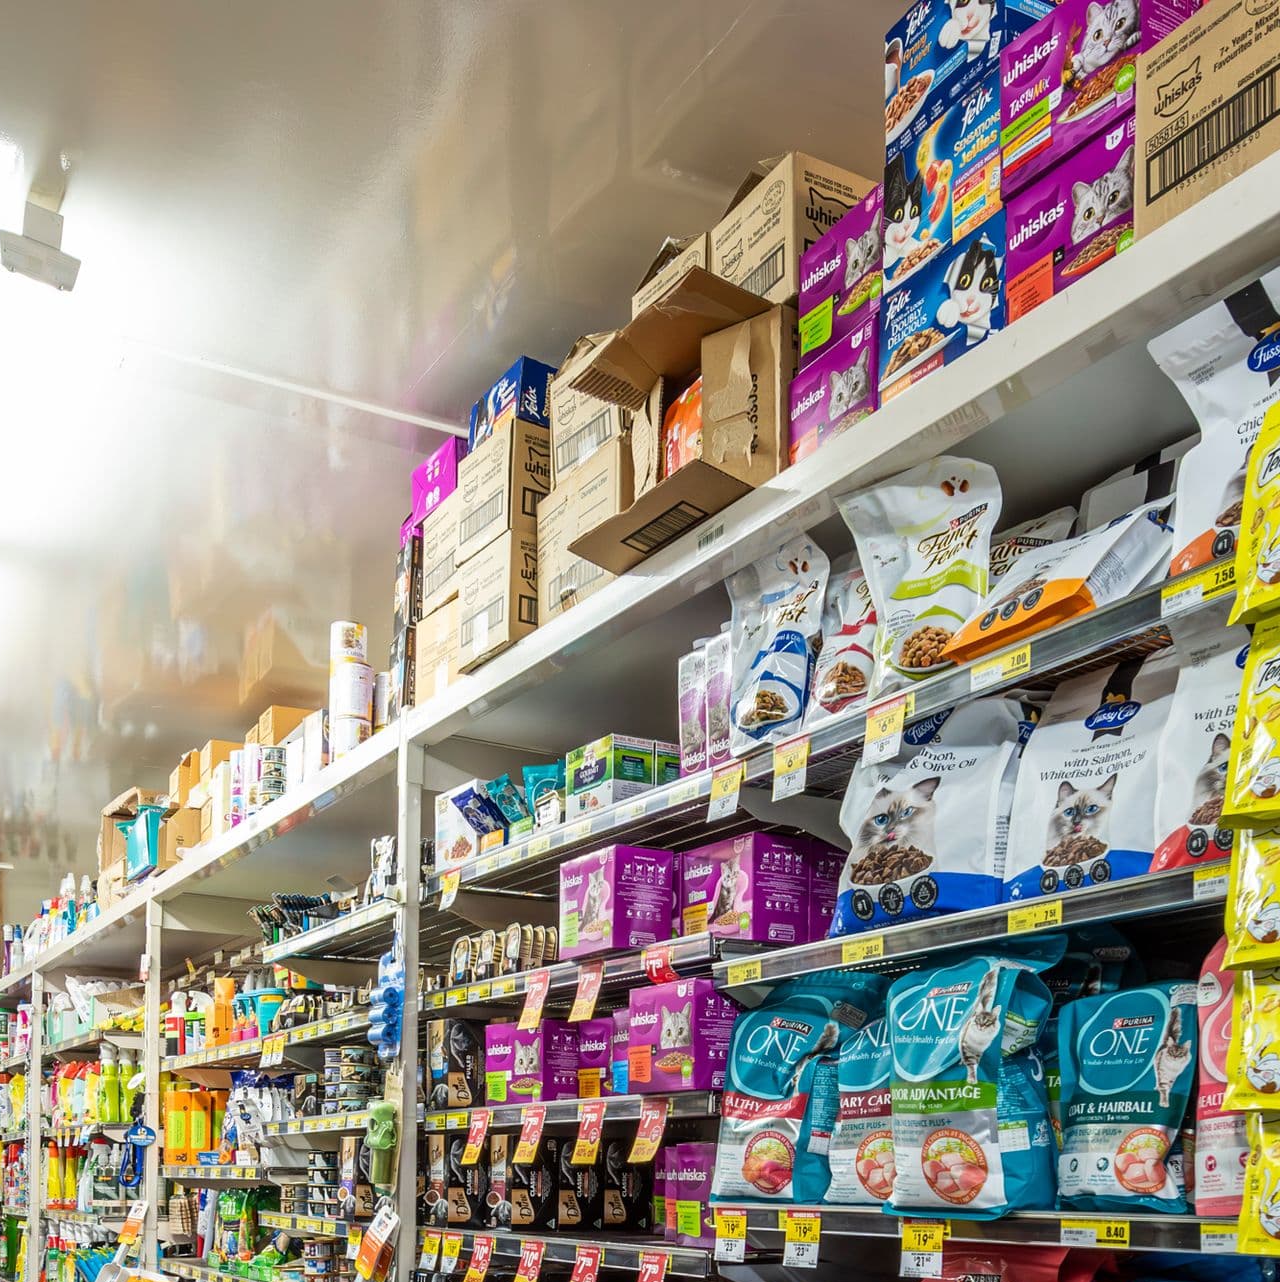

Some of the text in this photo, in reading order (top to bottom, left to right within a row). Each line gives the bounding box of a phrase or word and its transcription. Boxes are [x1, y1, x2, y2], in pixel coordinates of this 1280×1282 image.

[1231, 28, 1252, 46] Years
[1254, 7, 1280, 29] Mixed
[1004, 32, 1059, 87] whiskas
[1214, 39, 1252, 72] Favourites
[1254, 32, 1262, 42] in
[1154, 72, 1202, 116] whiskas
[961, 88, 994, 136] felix
[1149, 118, 1186, 151] 5058143
[1010, 201, 1064, 250] whiskas
[802, 254, 841, 292] whiskas
[1040, 770, 1093, 781] Whitefish
[1106, 760, 1130, 773] Olive
[1133, 751, 1146, 764] Oil
[1064, 757, 1089, 767] with
[630, 1013, 659, 1026] whiskas
[780, 1020, 810, 1034] PURINA
[898, 997, 968, 1032] ONE
[1123, 1016, 1153, 1026] PURINA
[487, 1045, 512, 1055] whiskas
[746, 1025, 807, 1065] ONE
[1090, 1028, 1153, 1056] ONE
[910, 1085, 981, 1101] ADVANTAGE
[1098, 1101, 1154, 1113] HAIRBALL
[1105, 1226, 1125, 1240] 8.40
